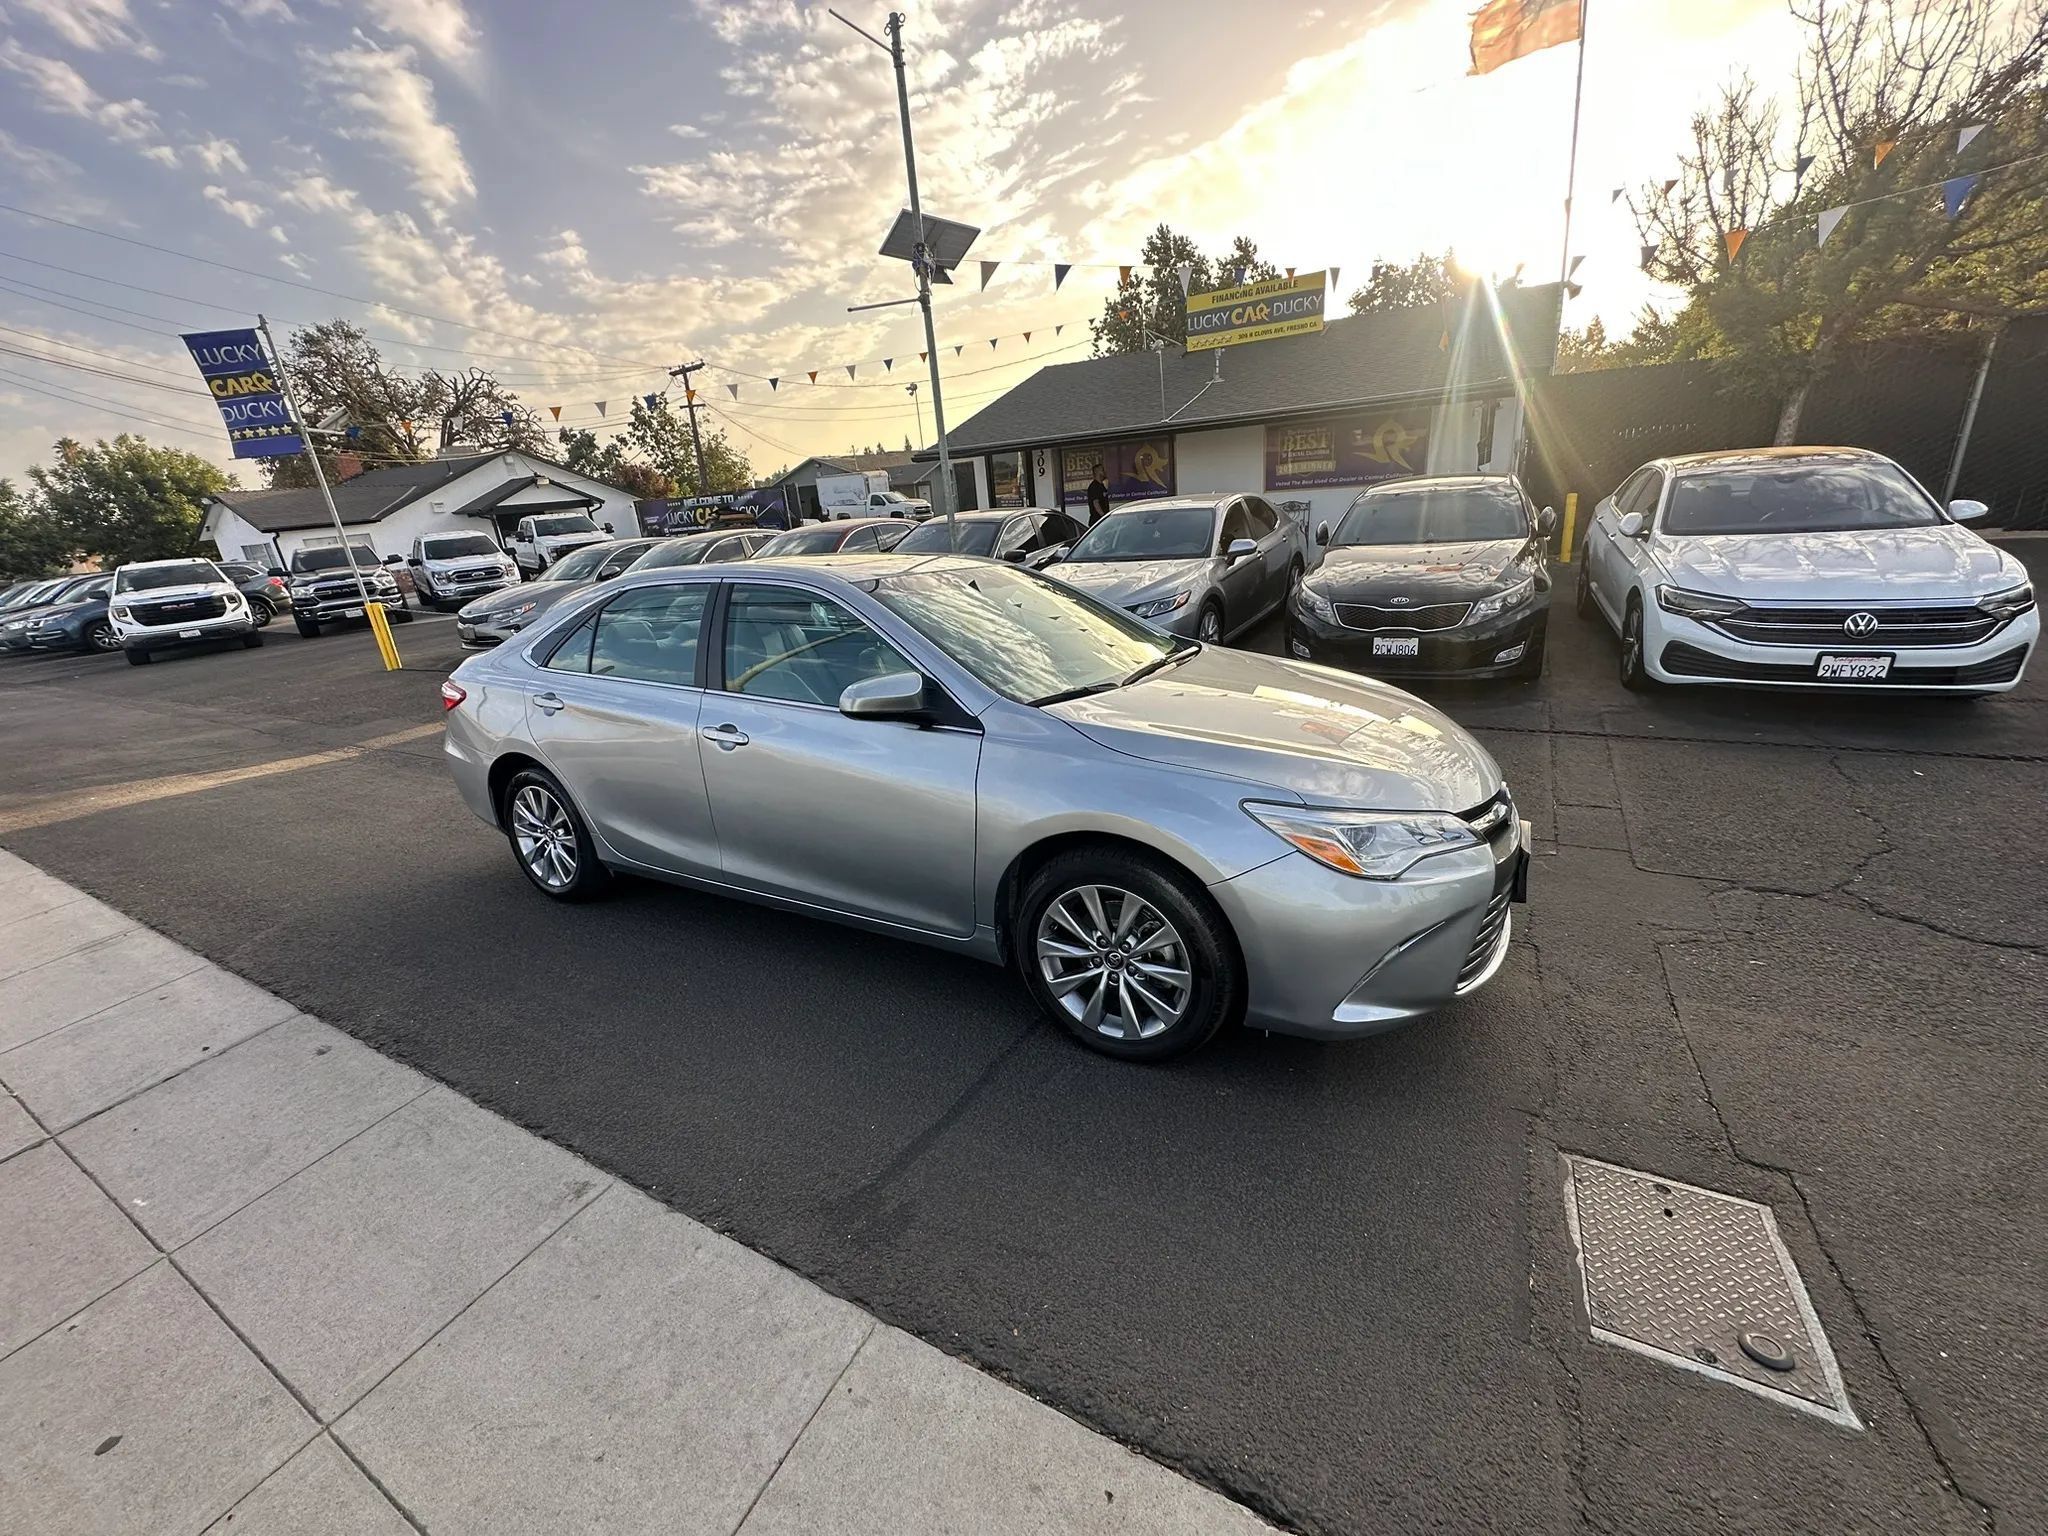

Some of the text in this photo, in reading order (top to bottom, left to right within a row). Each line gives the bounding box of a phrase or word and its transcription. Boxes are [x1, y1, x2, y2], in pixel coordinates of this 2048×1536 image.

[1212, 280, 1298, 304] FINANCING AVAILABLE
[1188, 311, 1229, 331] LUCKY
[1273, 294, 1322, 316] DUCKY
[1254, 328, 1272, 337] CLOVIS
[1287, 322, 1308, 331] FRESNO
[192, 343, 260, 366] LUCKY
[220, 400, 284, 422] DUCKY
[1284, 433, 1329, 450] BEST
[683, 494, 734, 506] WELCOME TO
[666, 510, 695, 525] LUCKY
[1374, 644, 1416, 656] 9CWJ806
[1821, 664, 1886, 678] 9WFY822
